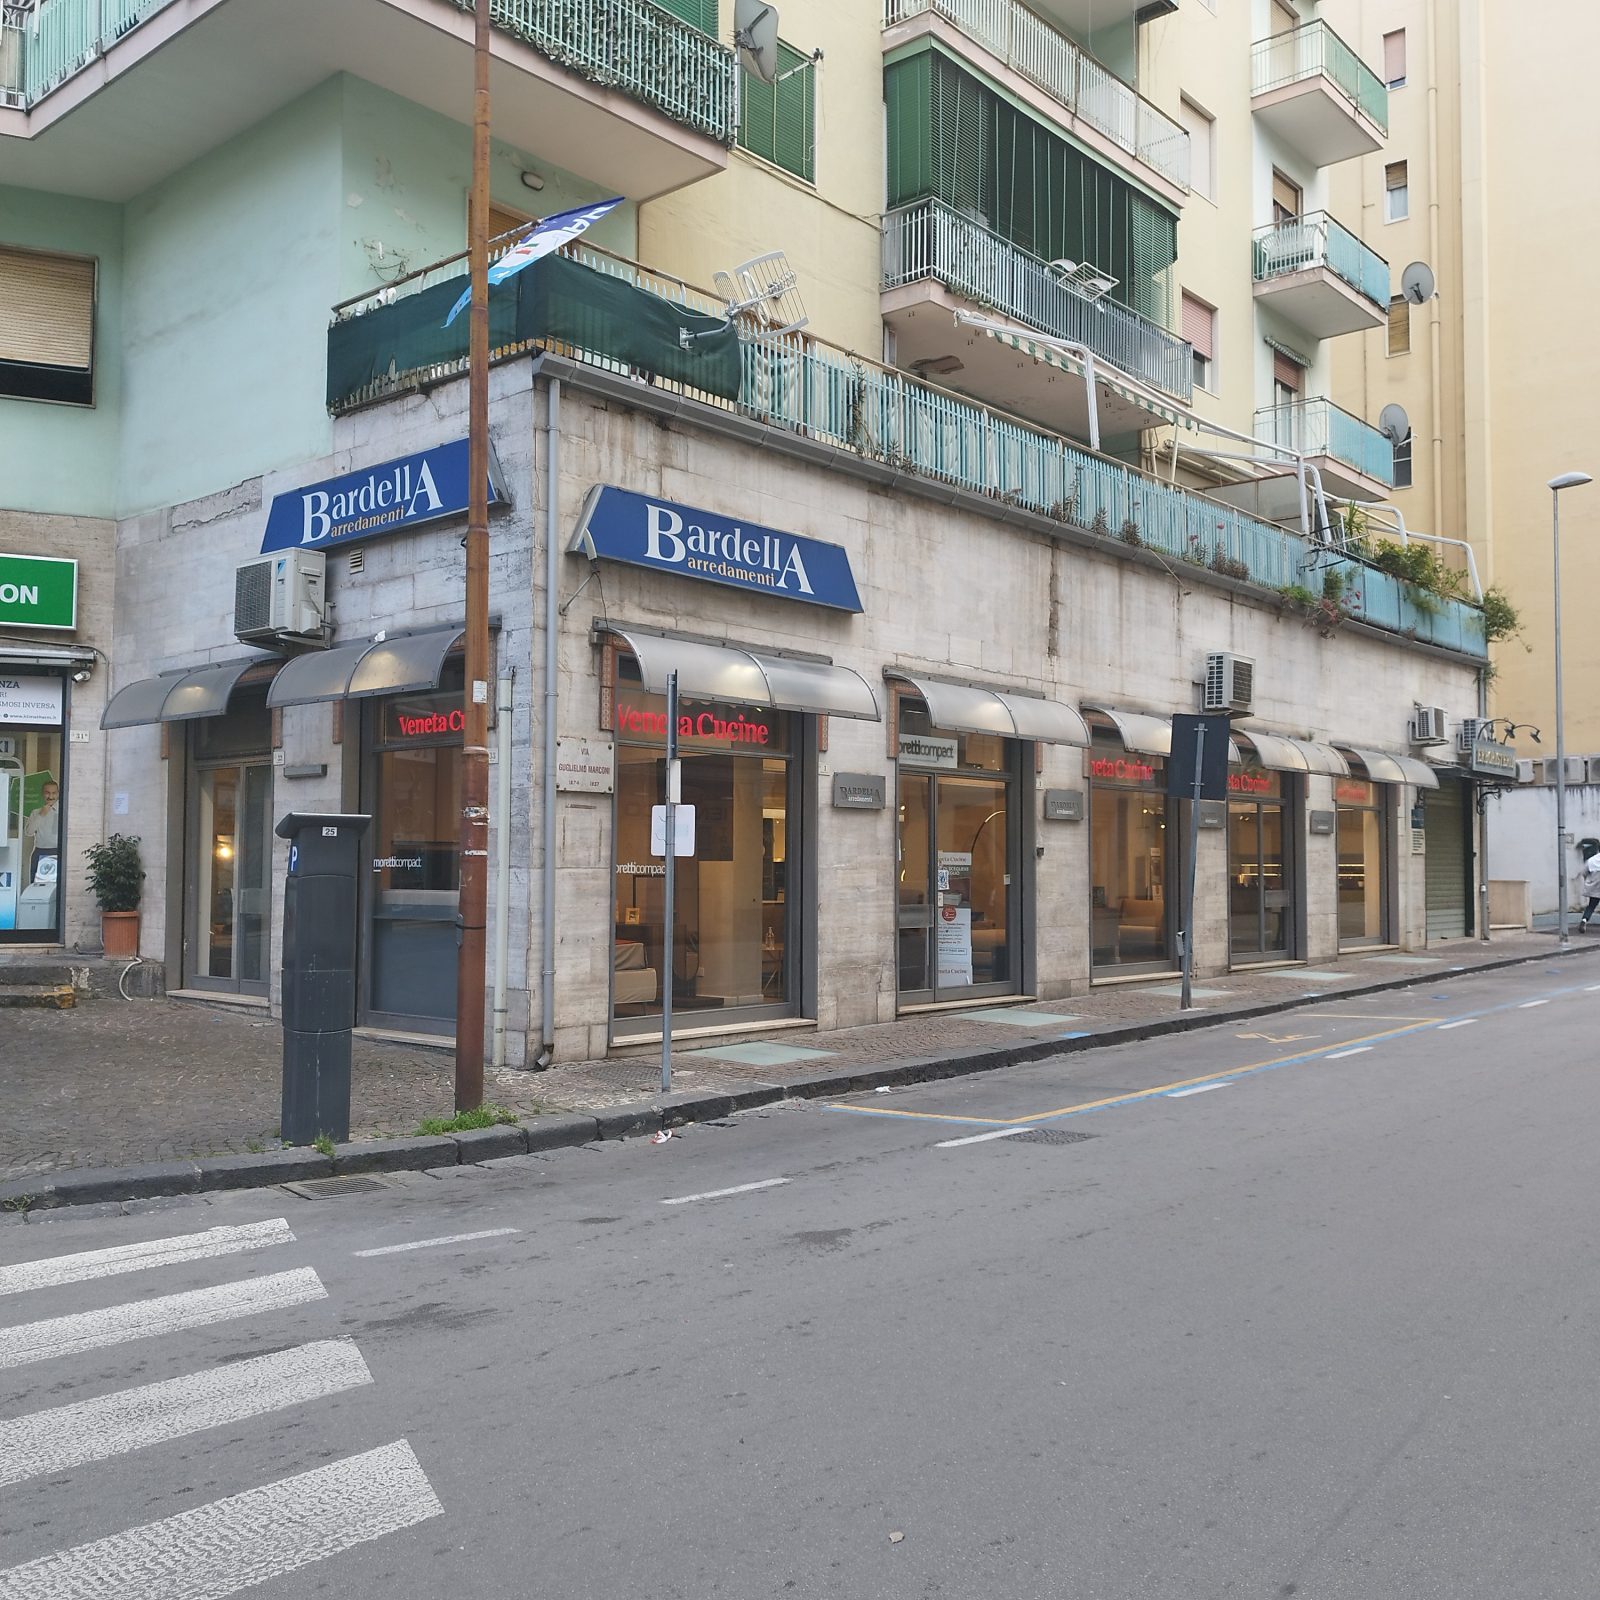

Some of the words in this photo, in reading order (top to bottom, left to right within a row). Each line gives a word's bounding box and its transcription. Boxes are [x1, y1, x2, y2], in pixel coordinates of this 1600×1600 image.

[330, 505, 404, 537] arredamenti
[687, 556, 776, 587] arredamenti
[0, 583, 38, 605] ON
[399, 712, 447, 736] Veneta
[617, 704, 693, 737] Venea
[697, 712, 769, 744] Cucine
[581, 748, 590, 756] VIA
[1115, 758, 1153, 781] Cucine
[324, 828, 336, 836] 25
[290, 846, 298, 872] P
